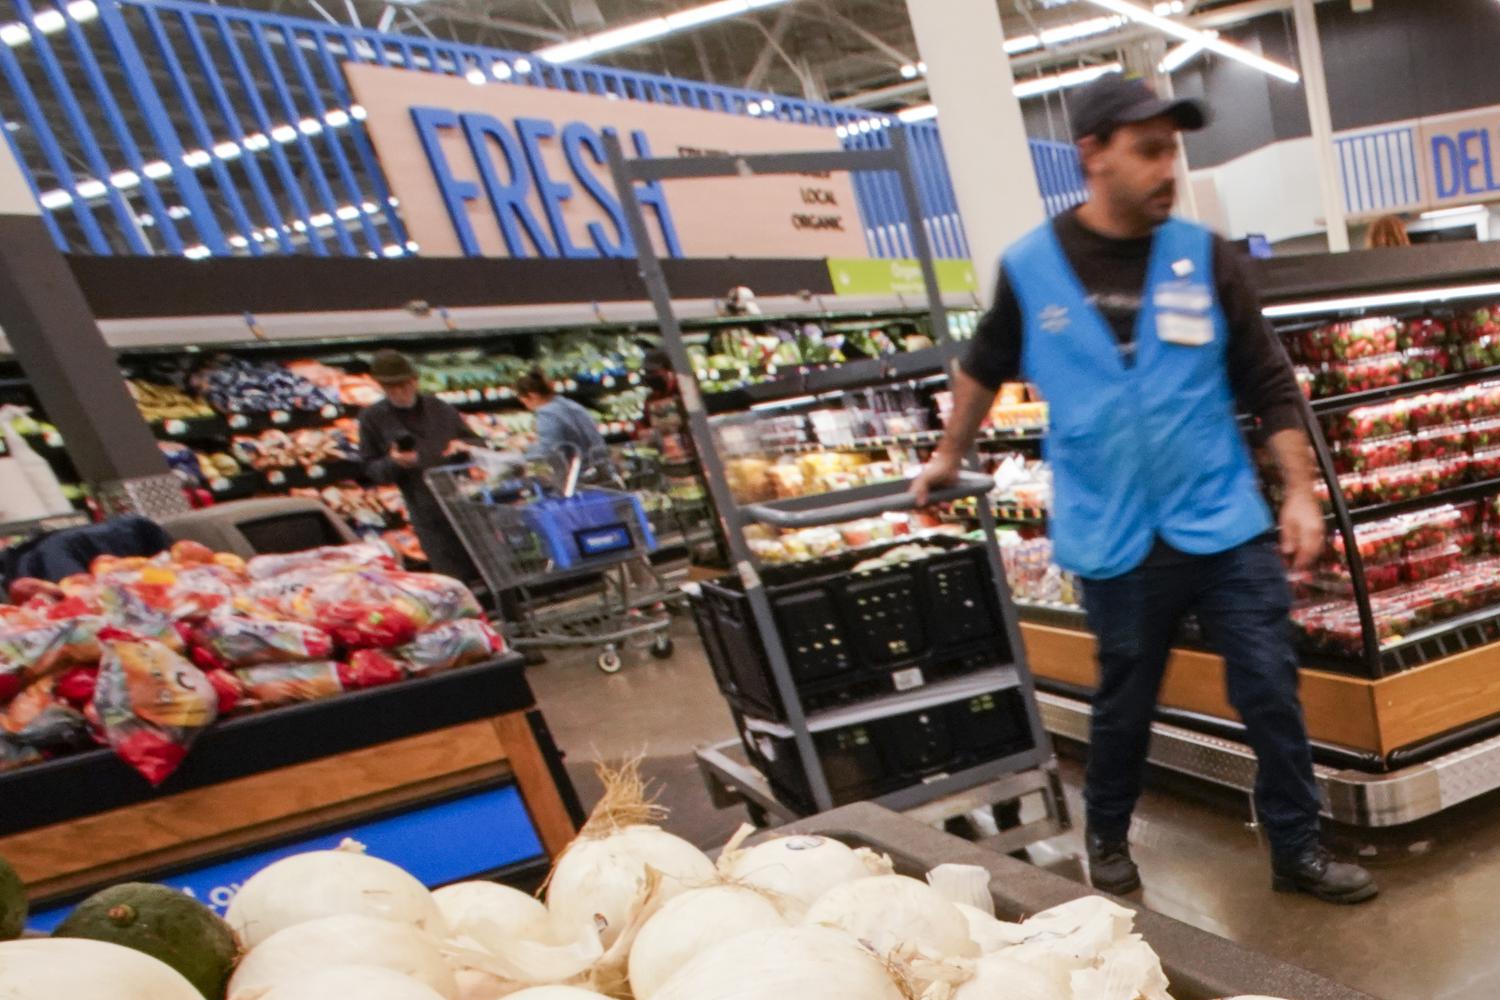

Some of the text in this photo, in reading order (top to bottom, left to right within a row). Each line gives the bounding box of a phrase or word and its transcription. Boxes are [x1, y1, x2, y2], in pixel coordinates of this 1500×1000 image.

[409, 105, 686, 259] FRESH
[800, 188, 837, 206] LOCAL
[791, 214, 844, 232] ORGANIC
